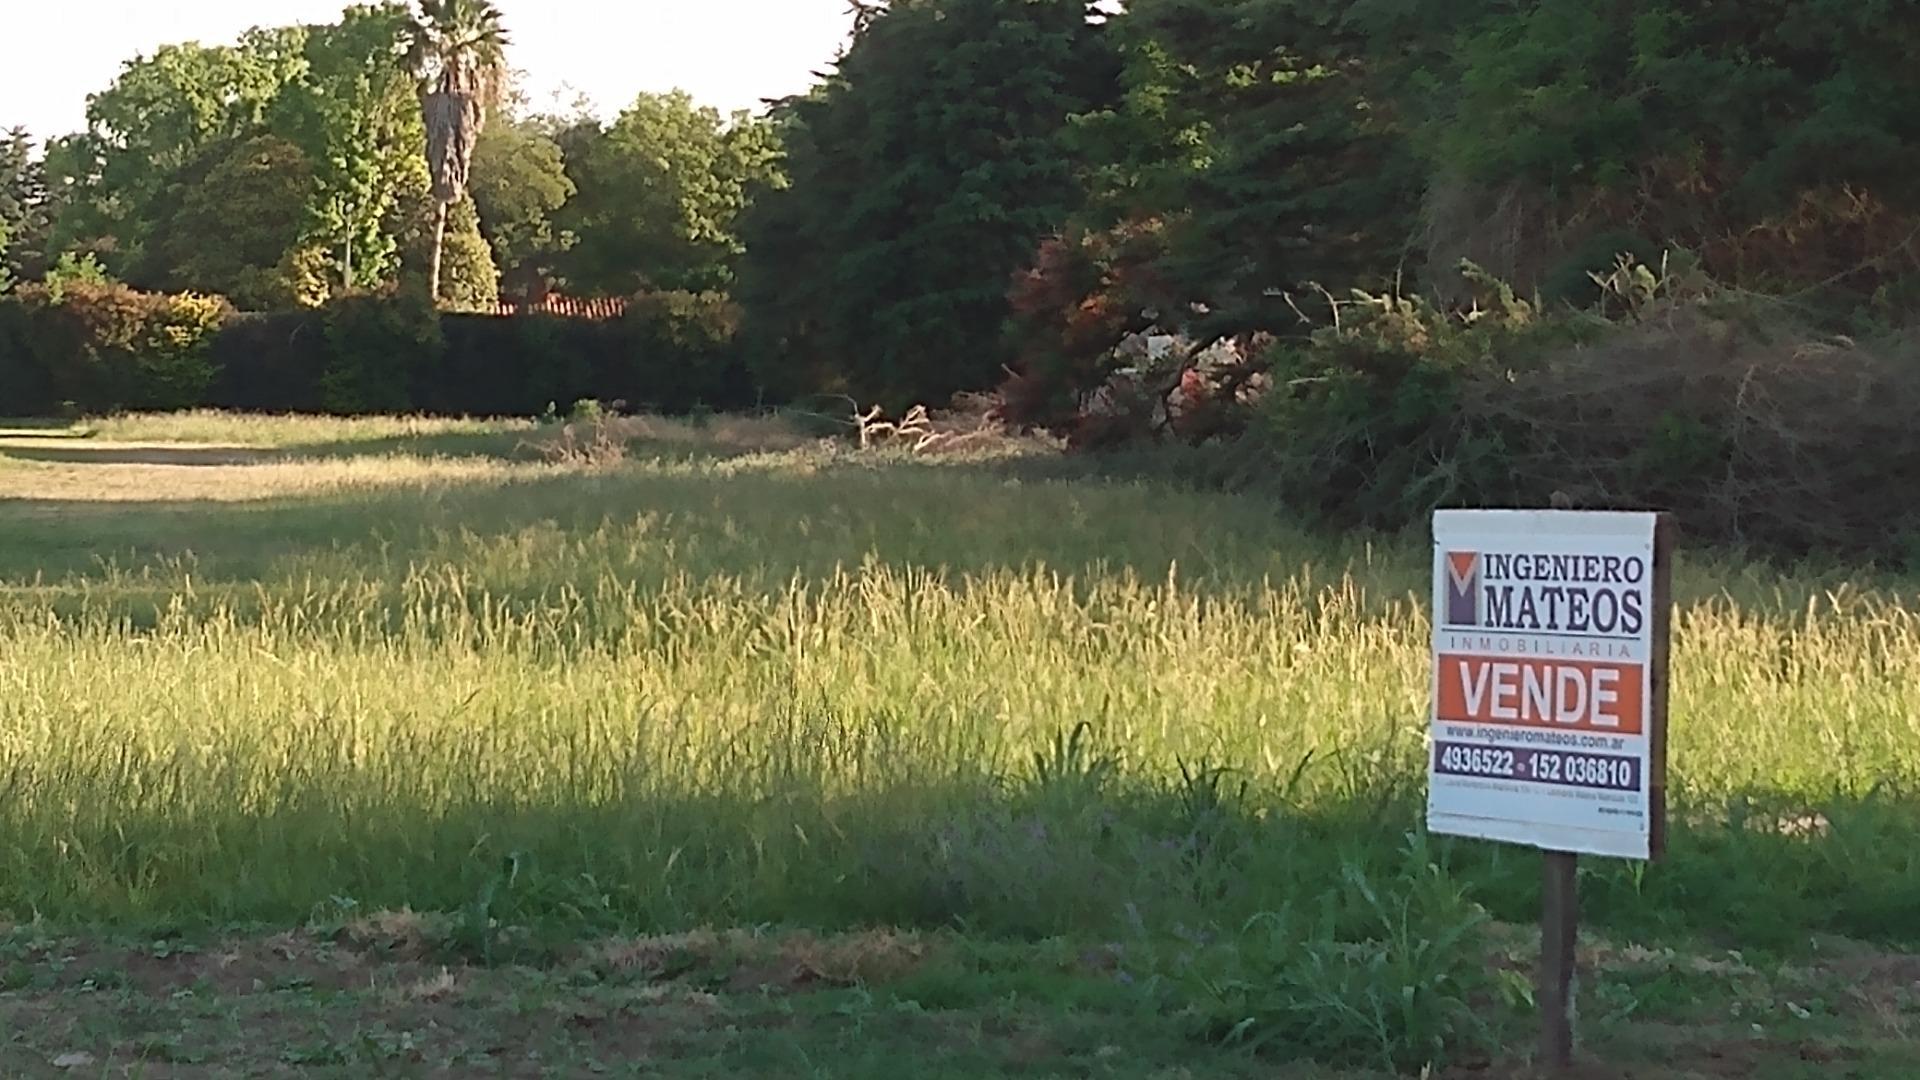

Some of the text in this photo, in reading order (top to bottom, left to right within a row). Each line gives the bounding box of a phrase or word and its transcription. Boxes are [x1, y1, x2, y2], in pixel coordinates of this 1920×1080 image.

[1484, 553, 1643, 583] INGENIERO
[1484, 585, 1643, 634] MATEOS
[1451, 636, 1631, 658] INMOBILIARIA
[1460, 660, 1619, 727] VENDE
[1447, 725, 1624, 750] www.ingenieromateos.com.ar
[1441, 746, 1514, 776] 4936522
[1529, 752, 1561, 779] 152
[1564, 756, 1631, 787] 036810
